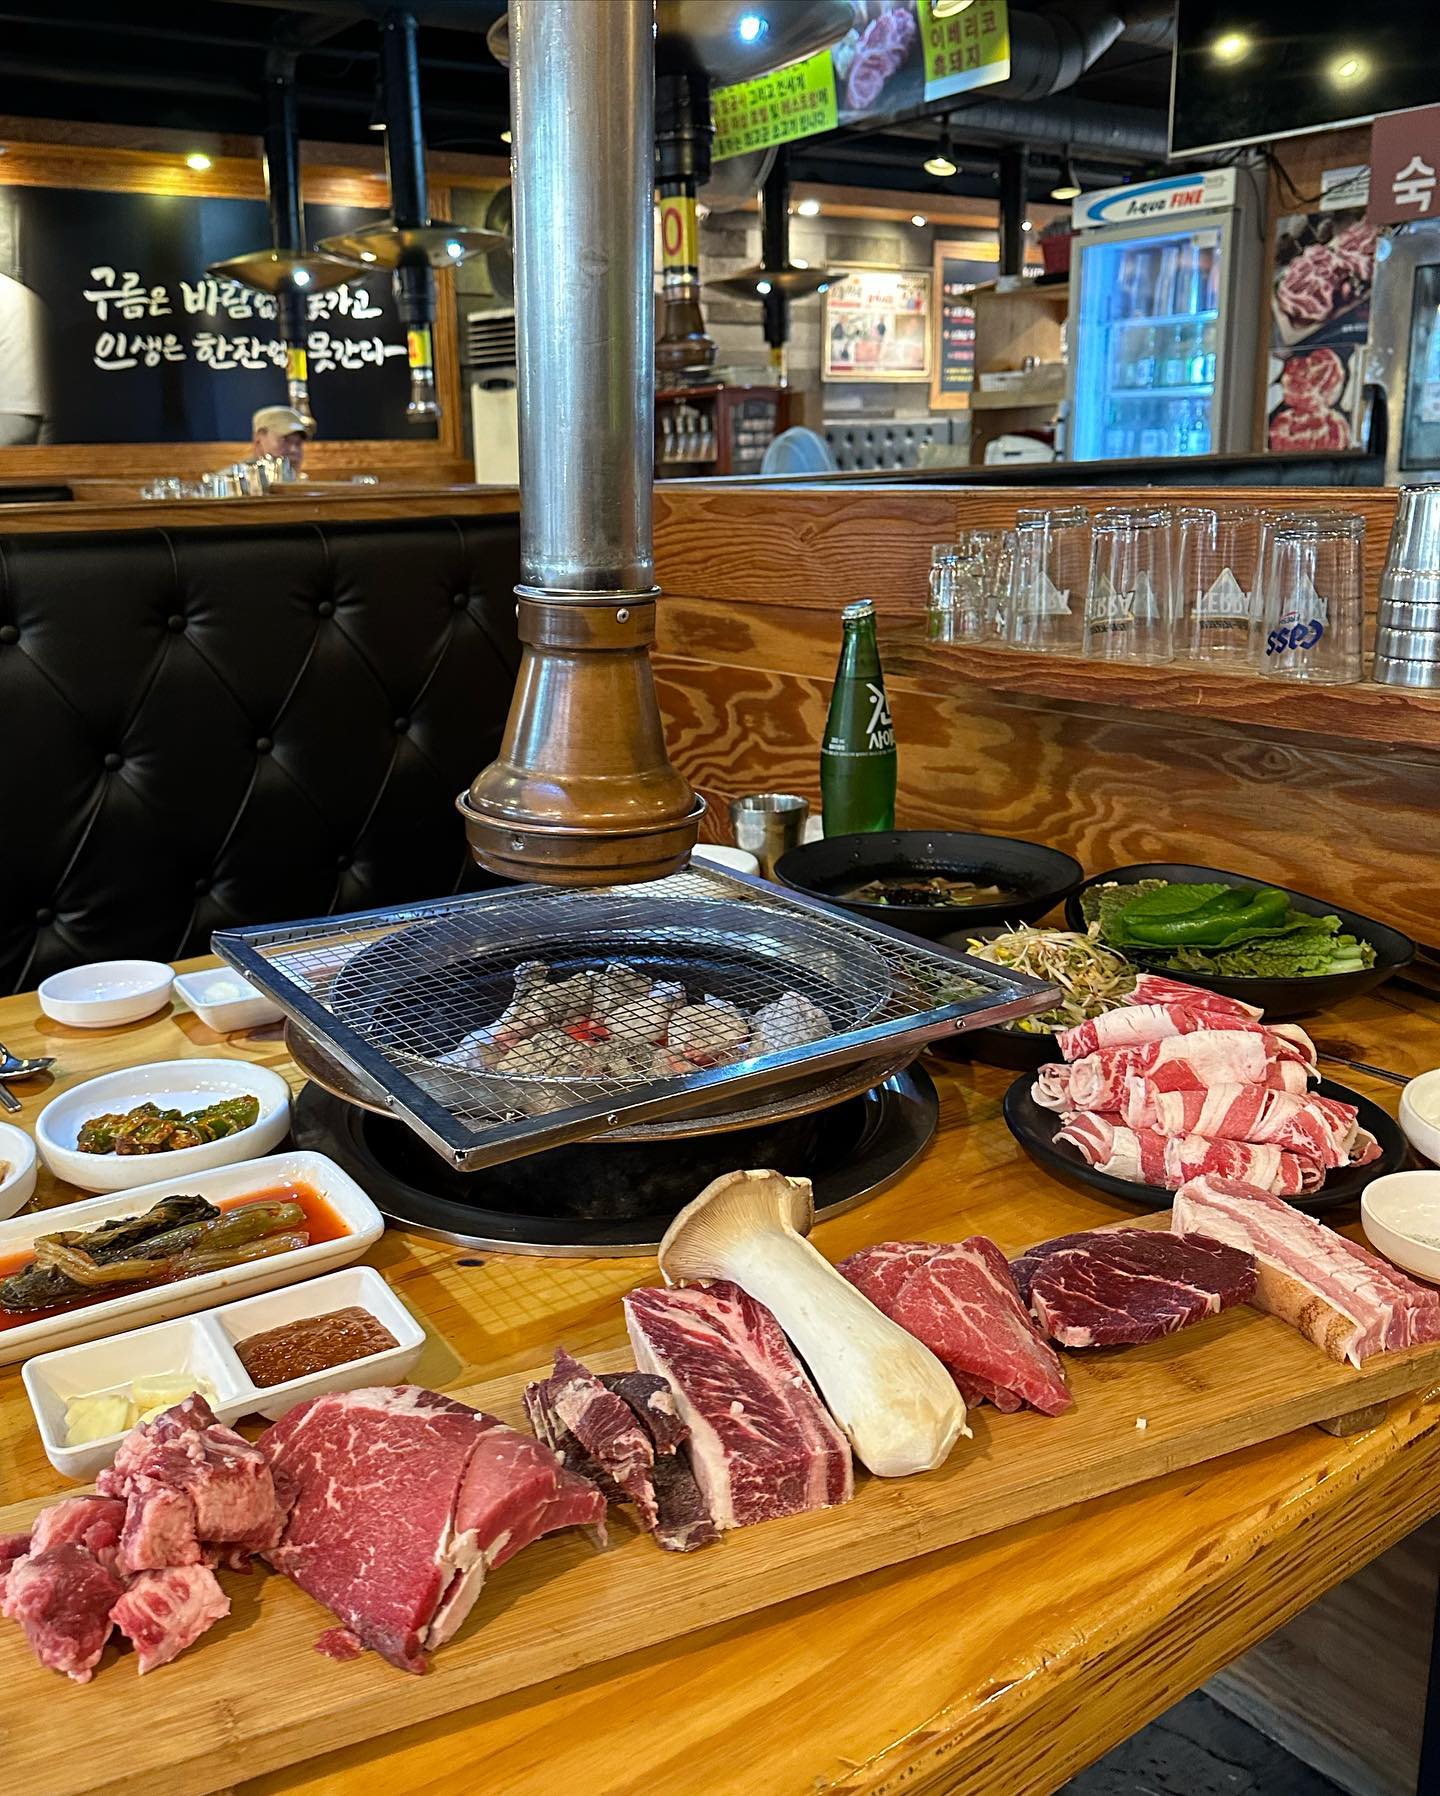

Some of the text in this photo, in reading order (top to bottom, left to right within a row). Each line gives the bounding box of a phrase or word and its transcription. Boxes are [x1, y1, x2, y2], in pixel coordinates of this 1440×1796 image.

[930, 10, 997, 49] 이베리코
[1168, 187, 1204, 208] FINE
[1392, 155, 1437, 212] 숙
[82, 266, 173, 321] 구름은
[179, 280, 279, 320] 바람없
[94, 331, 187, 370] 인생은
[191, 331, 289, 370] 한잔없
[305, 331, 407, 374] 못간다
[868, 729, 897, 750] 사이
